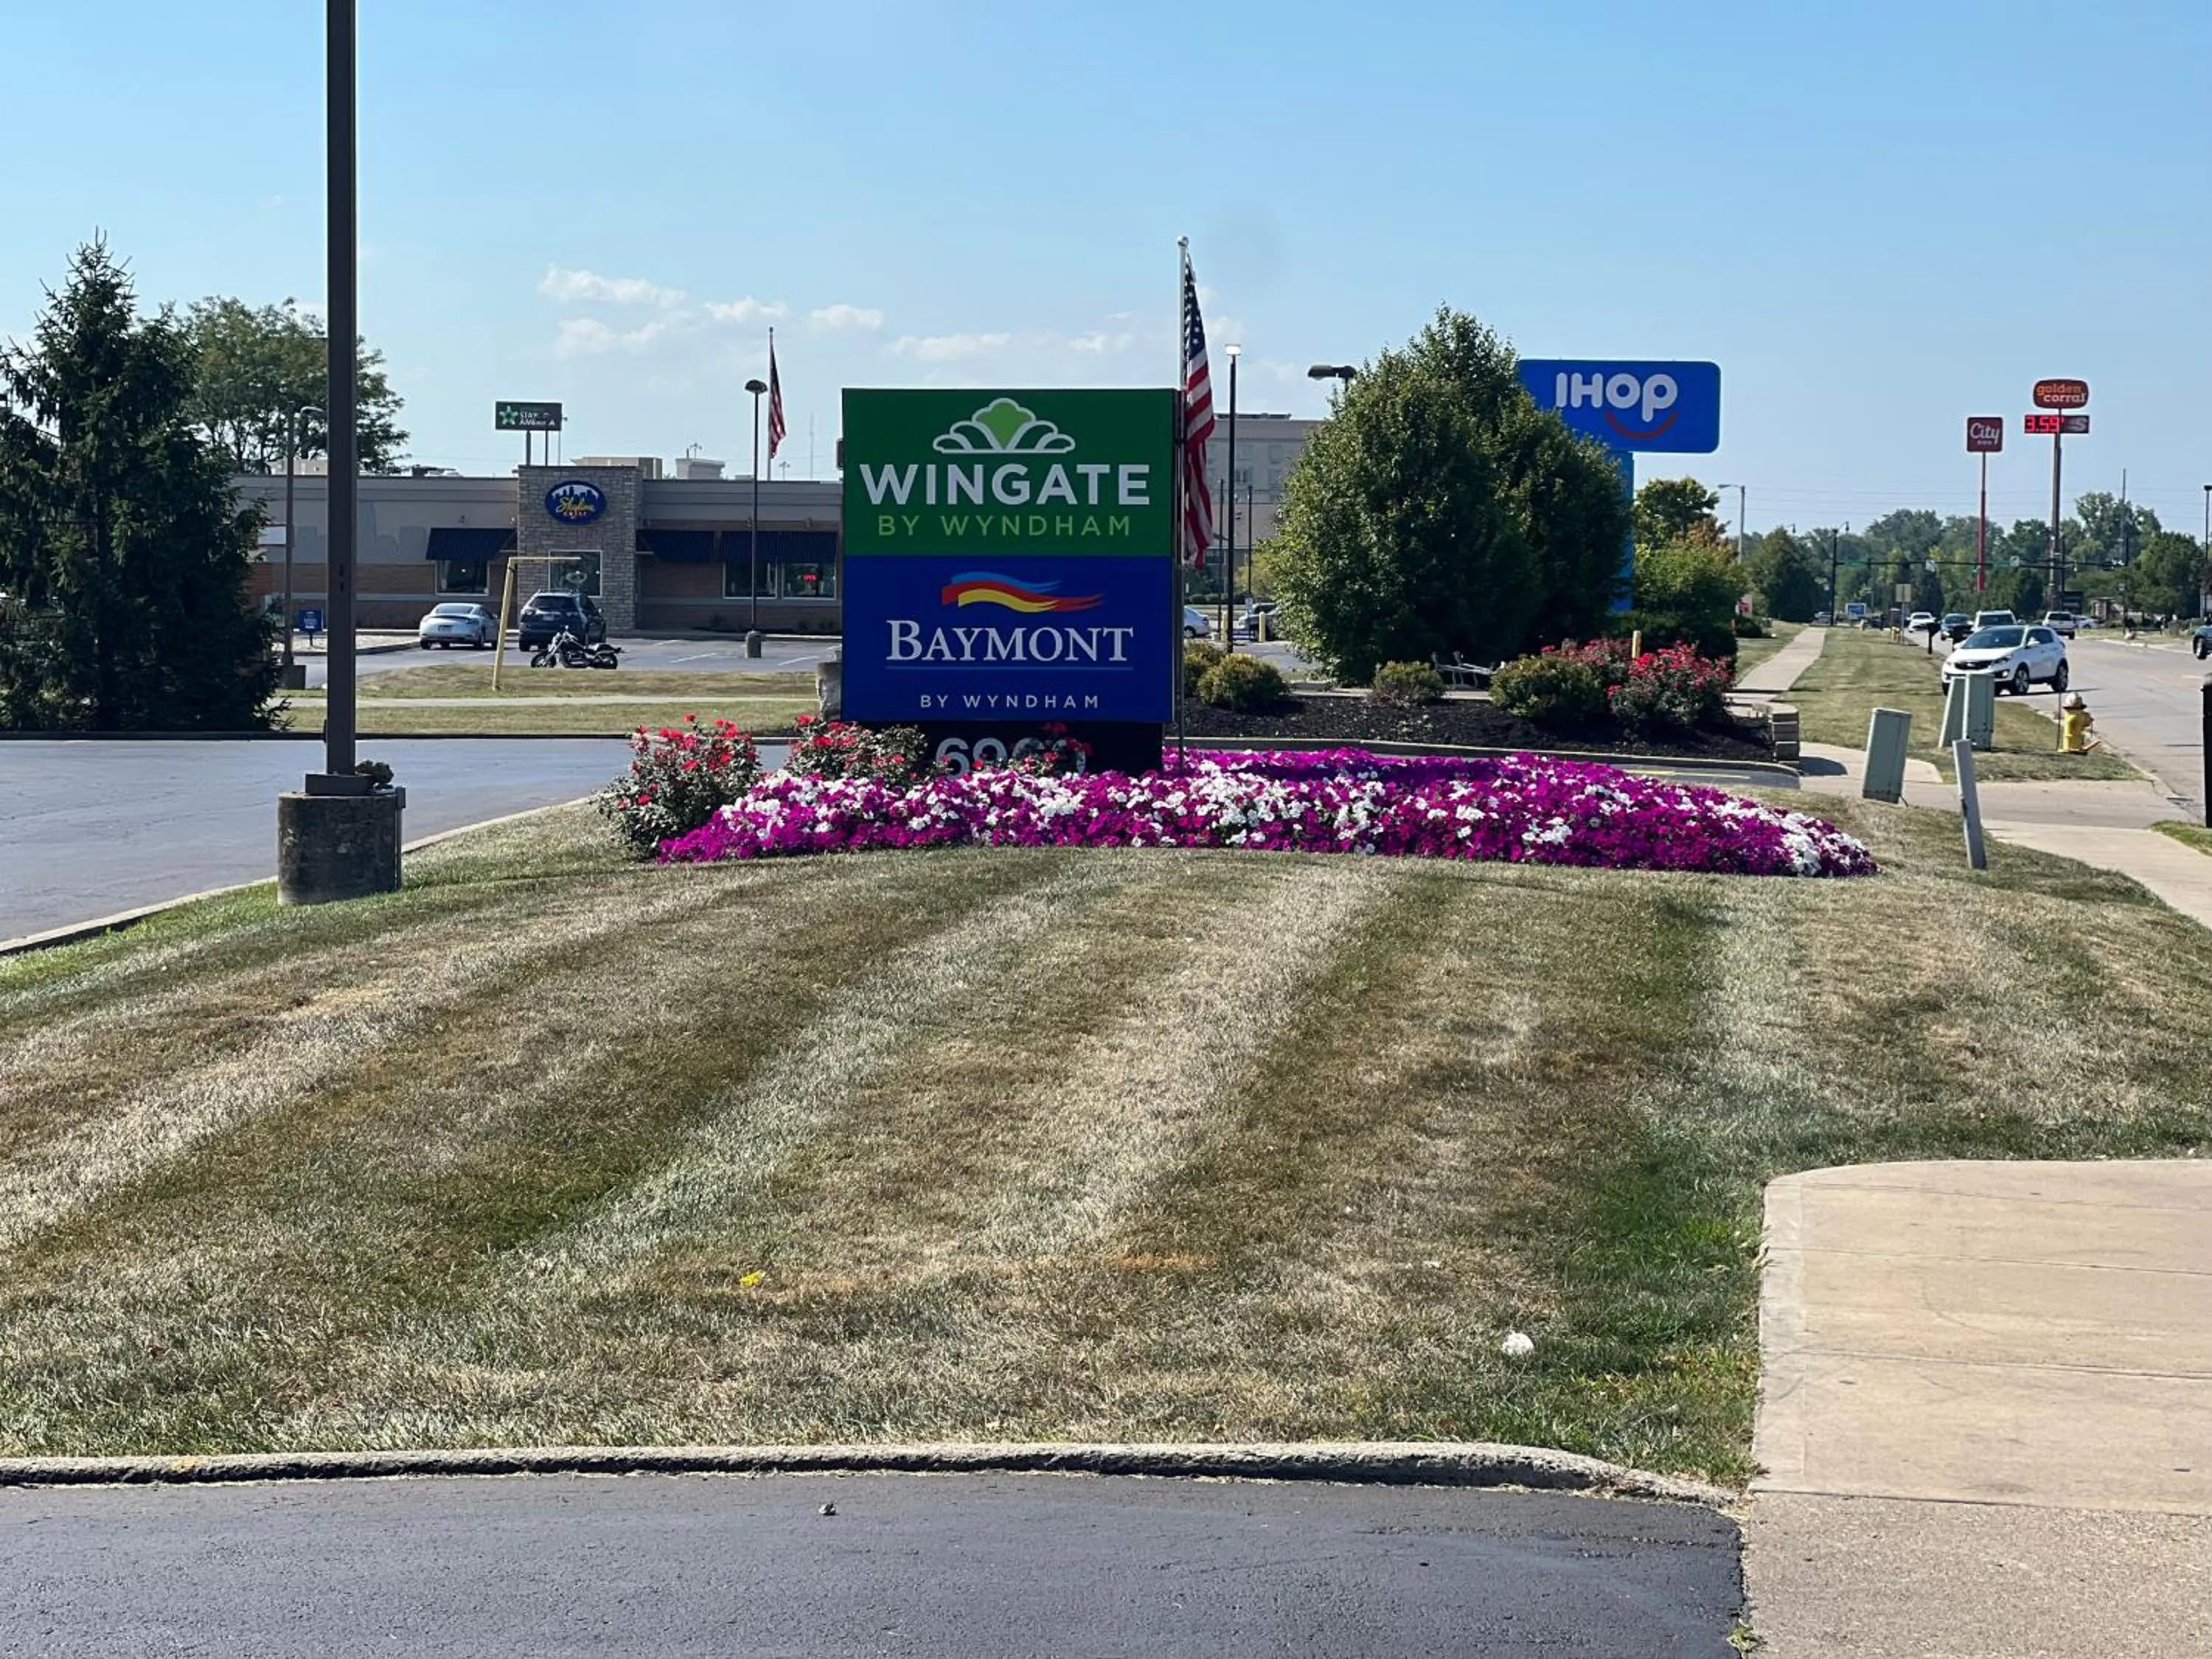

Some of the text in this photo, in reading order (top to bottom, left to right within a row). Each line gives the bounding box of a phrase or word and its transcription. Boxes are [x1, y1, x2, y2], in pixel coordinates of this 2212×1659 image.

[2037, 383, 2081, 396] golden
[2043, 393, 2085, 403] corral
[1969, 422, 2000, 445] City
[860, 465, 1150, 505] WINGATE
[879, 516, 1130, 536] BY WYNDHAM
[886, 621, 1133, 661] BAYMONT
[920, 695, 1098, 708] BY WYNDHAM
